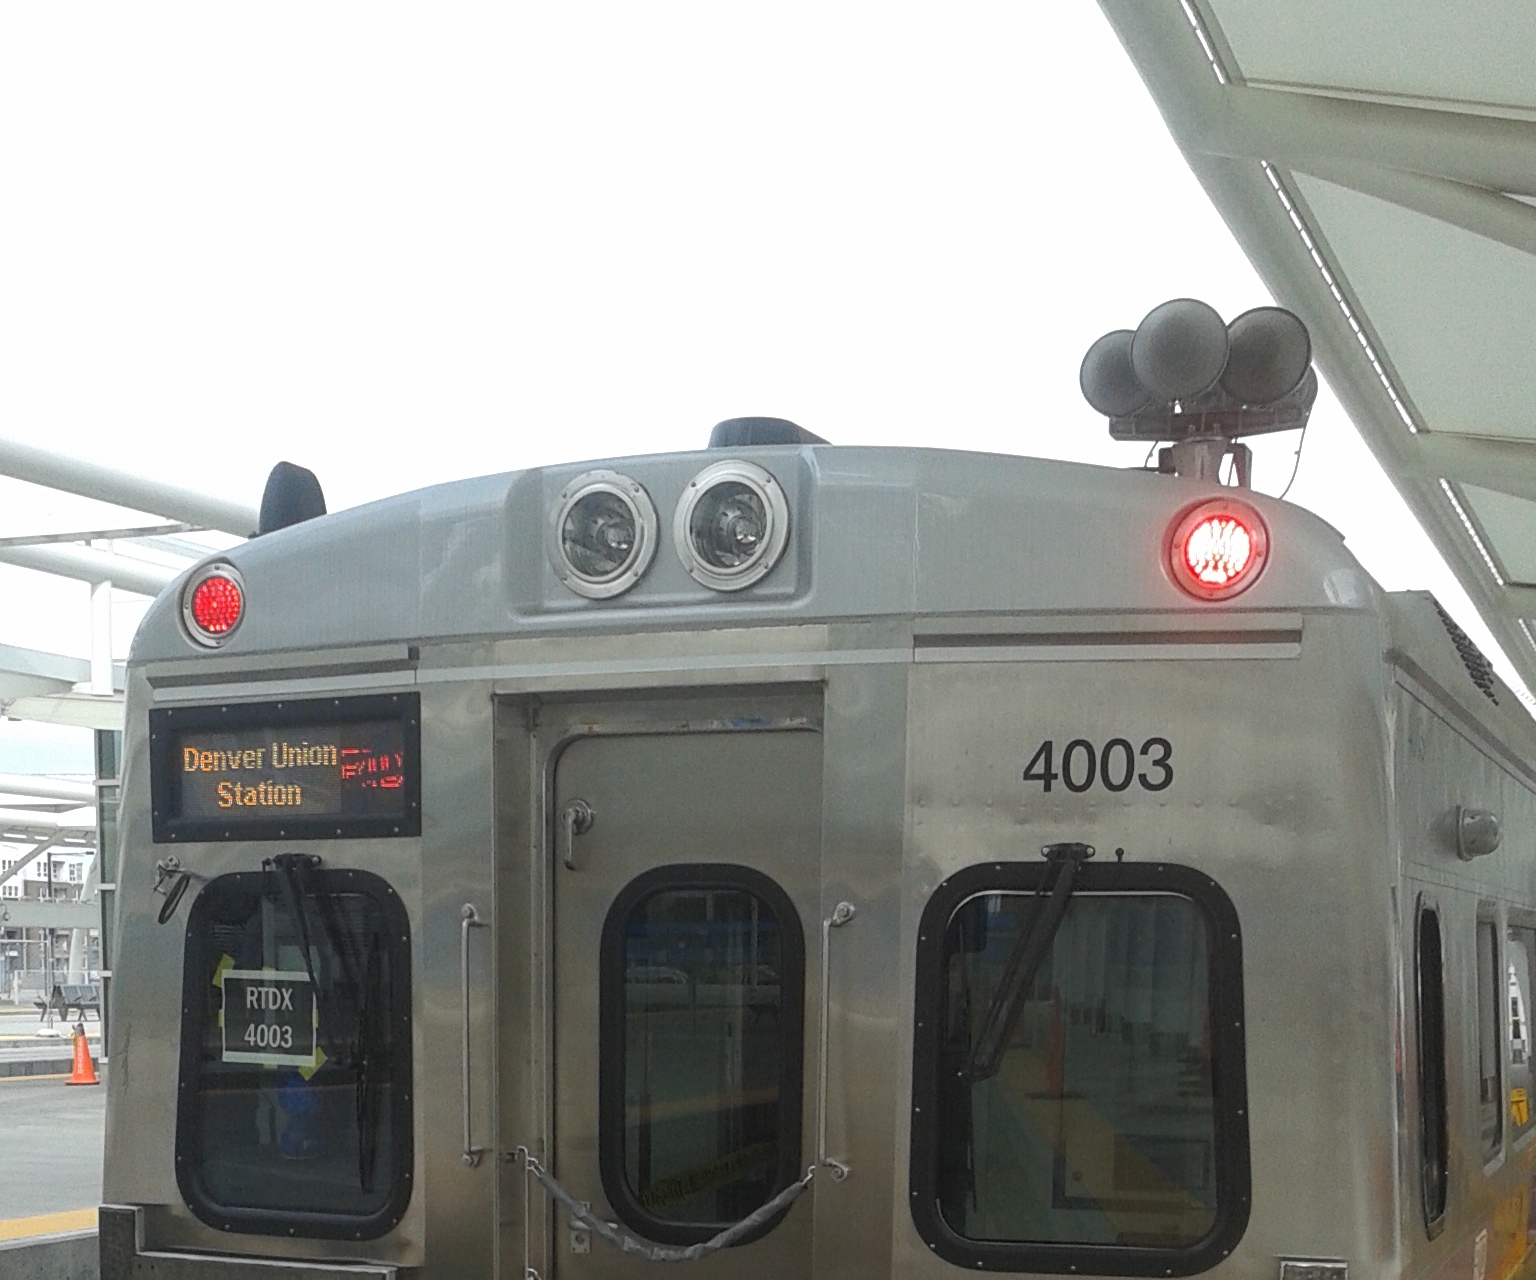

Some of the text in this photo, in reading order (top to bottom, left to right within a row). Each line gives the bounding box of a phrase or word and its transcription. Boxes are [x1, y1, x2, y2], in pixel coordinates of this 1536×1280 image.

[184, 747, 266, 772] Denver
[271, 741, 338, 768] Union
[1023, 737, 1174, 793] 4003
[217, 779, 302, 808] Station
[246, 986, 293, 1011] RTDX
[244, 1023, 293, 1048] 4003
